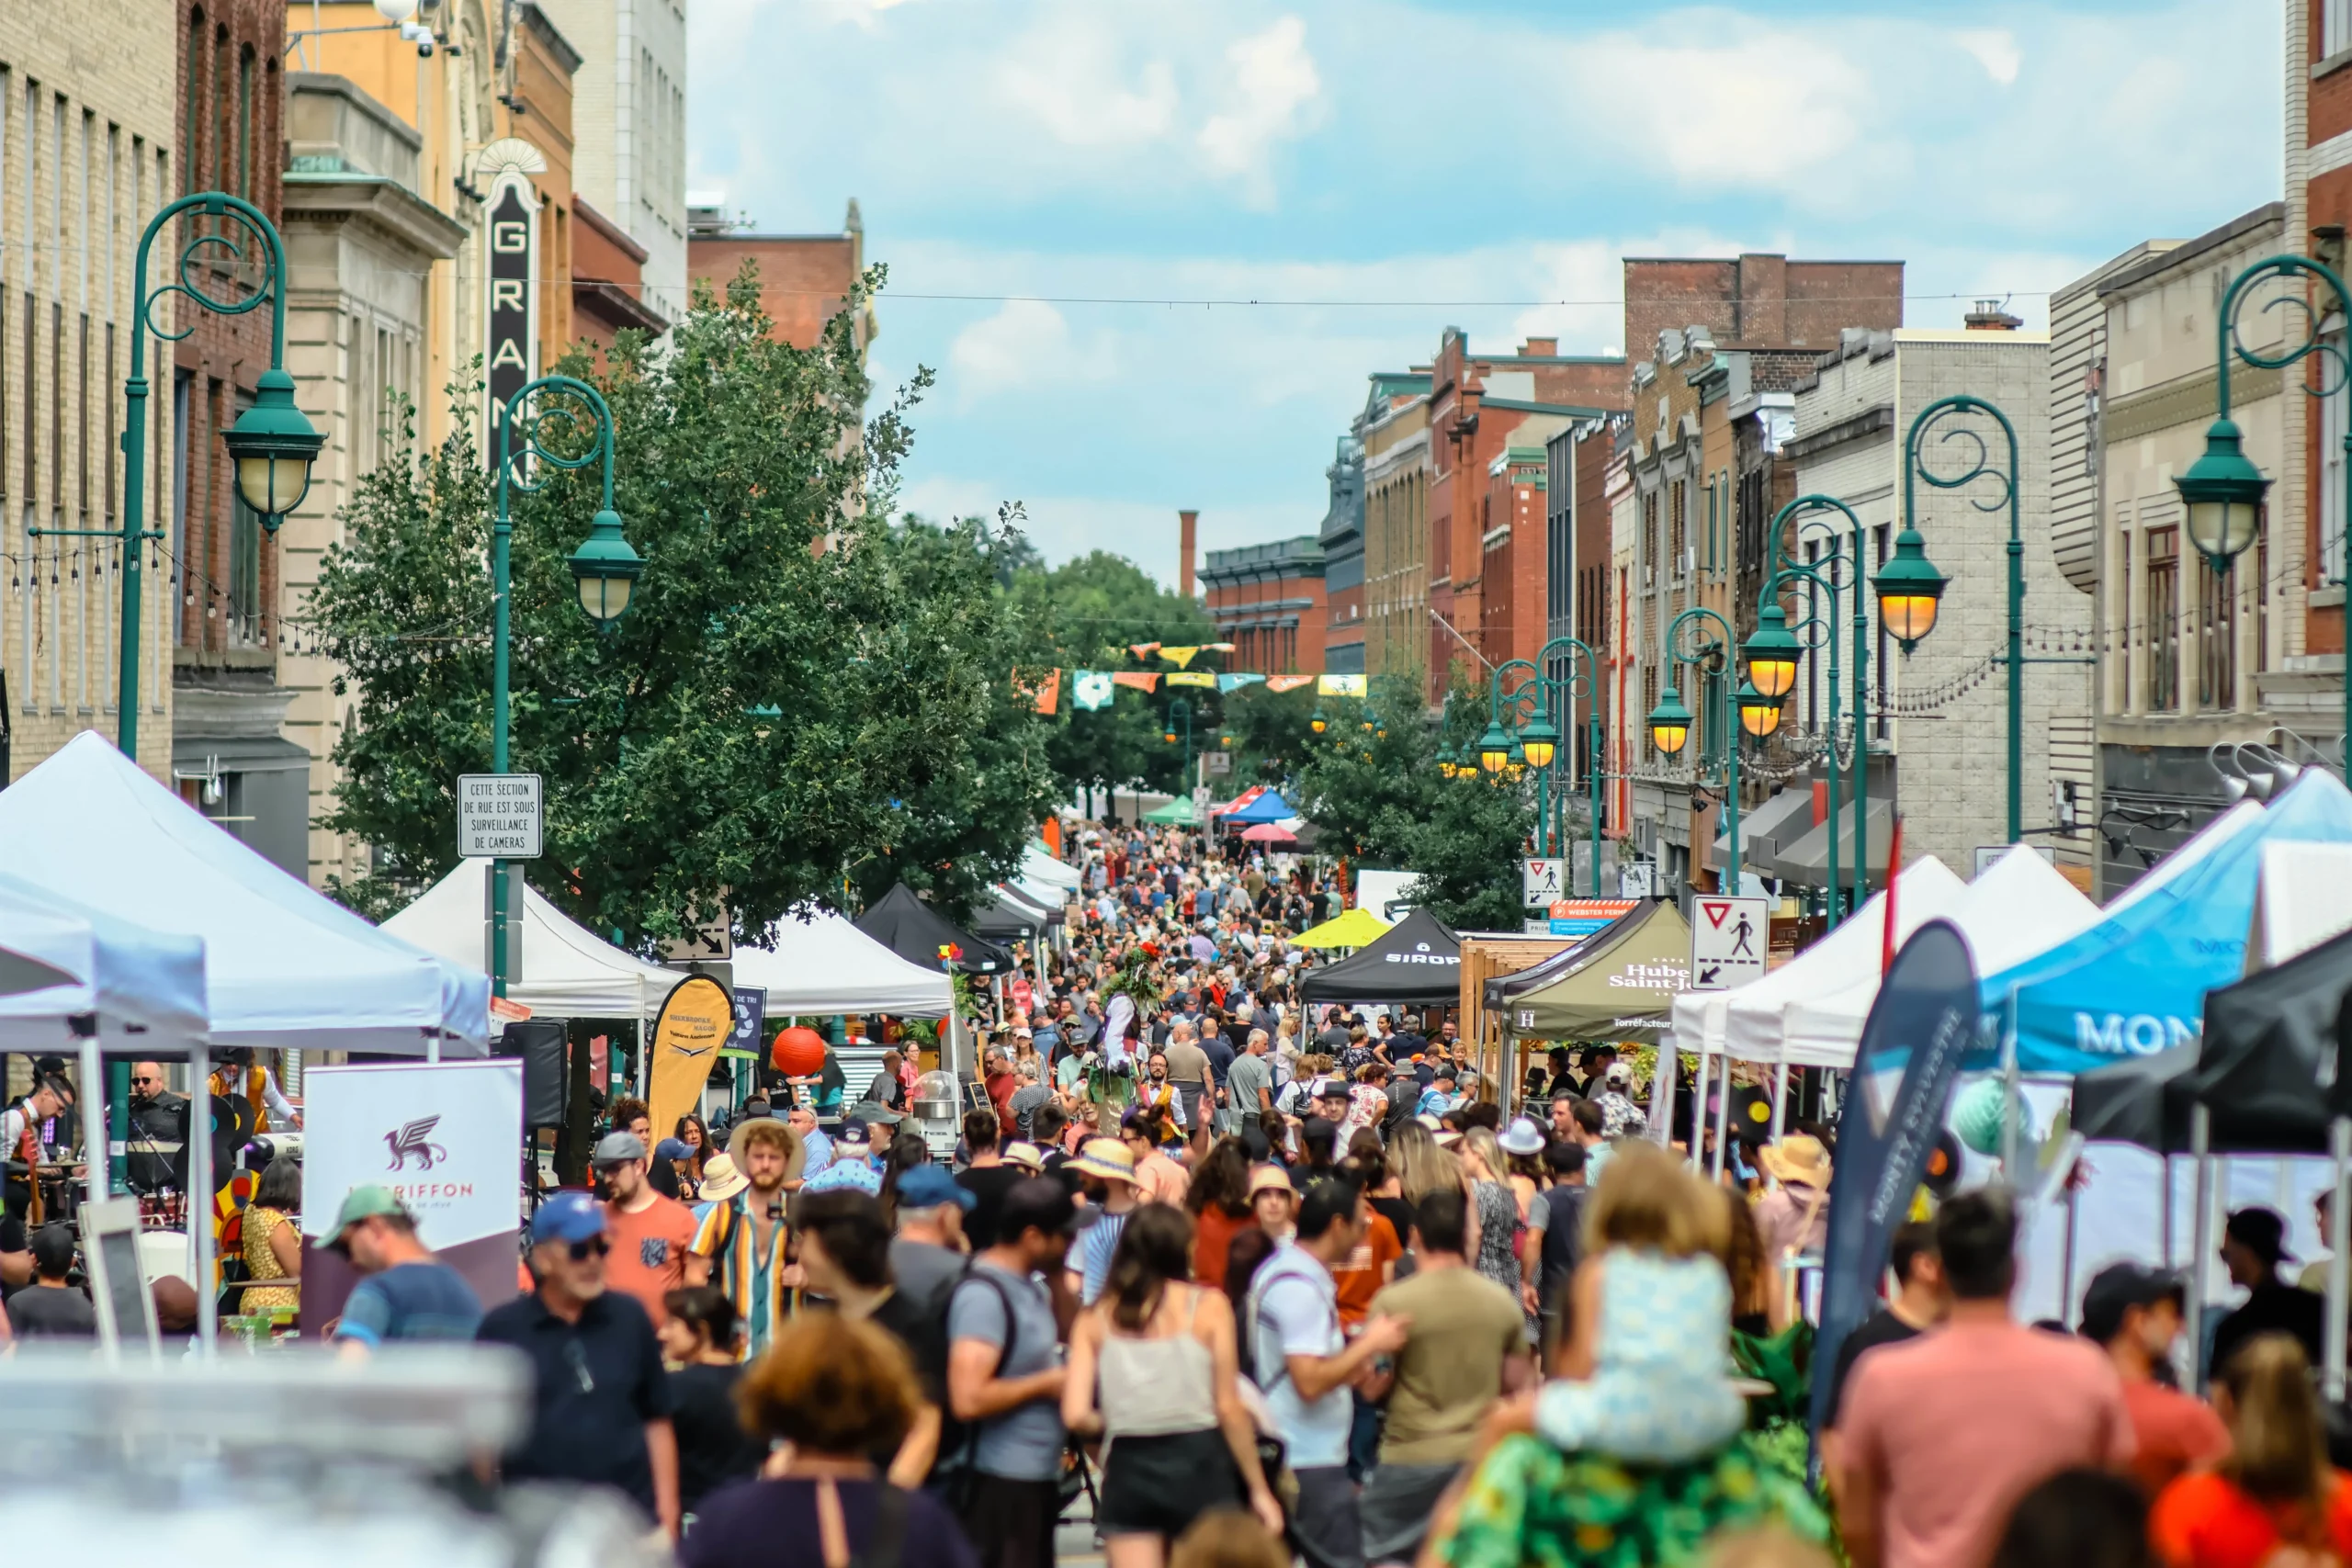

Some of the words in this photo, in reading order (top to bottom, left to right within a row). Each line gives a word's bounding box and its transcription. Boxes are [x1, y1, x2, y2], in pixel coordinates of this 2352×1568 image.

[470, 784, 493, 795] CETTE
[496, 784, 529, 795] SECTION
[464, 801, 474, 813] DE
[478, 801, 493, 813] RUE
[497, 801, 511, 813] EST
[514, 801, 535, 813] SOUS
[471, 819, 528, 830] SURVEILLANCE
[475, 837, 484, 849] DE
[488, 837, 525, 849] CAMERAS
[1385, 953, 1462, 965] SIROP
[736, 995, 745, 1003] DE
[747, 996, 757, 1004] TRI
[669, 1014, 712, 1024] SHERBROOKE
[1521, 1013, 1534, 1027] H
[1613, 1018, 1672, 1029] Torréfacteur
[669, 1030, 689, 1039] Voitures
